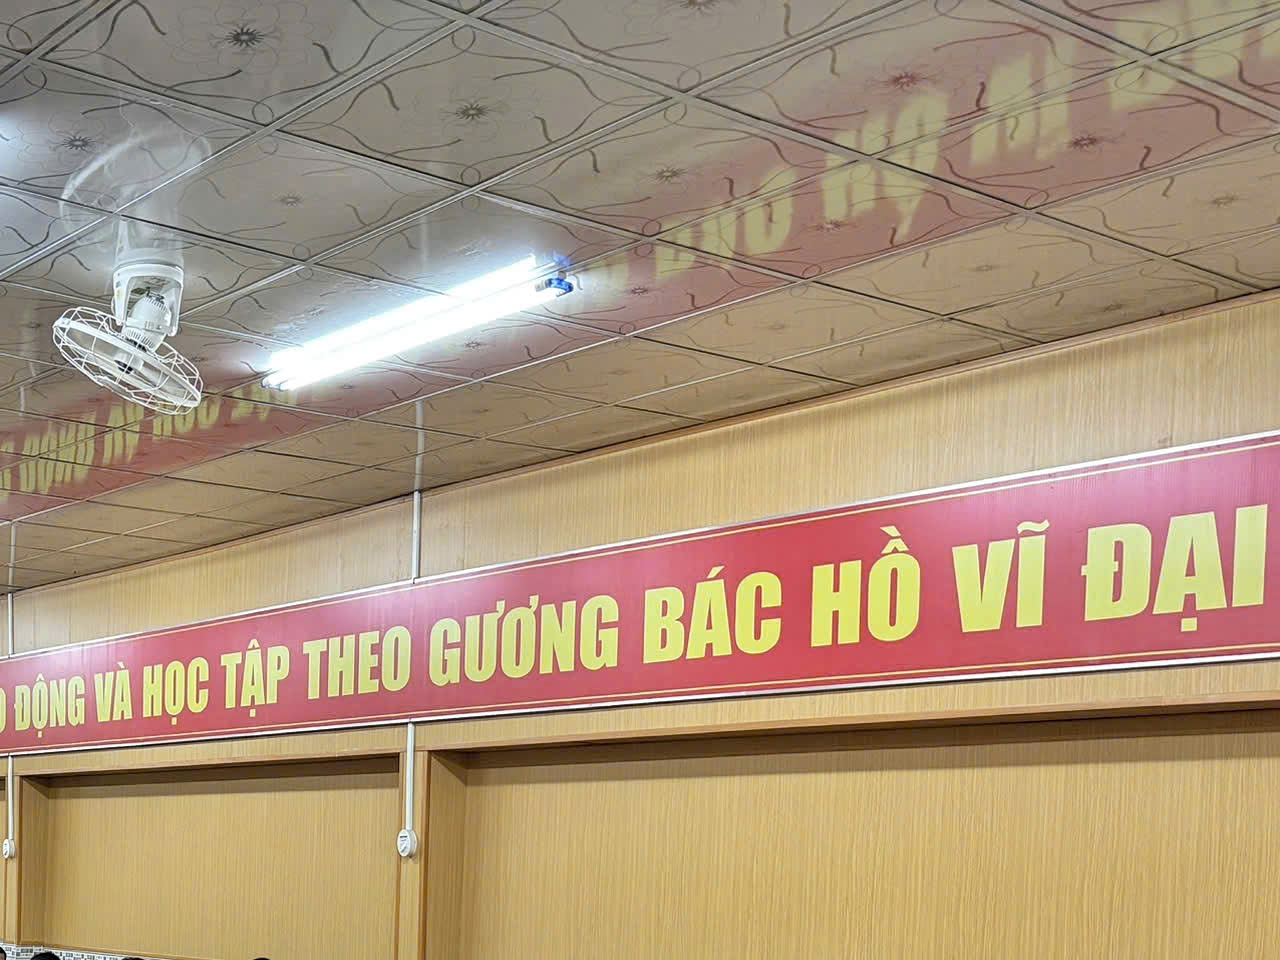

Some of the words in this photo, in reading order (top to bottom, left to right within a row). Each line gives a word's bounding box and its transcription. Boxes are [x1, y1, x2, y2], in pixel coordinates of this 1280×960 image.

[14, 672, 86, 739] ĐỘNG
[94, 661, 133, 723] VÀ
[142, 656, 210, 726] HỌC
[220, 638, 291, 718] TẬP
[303, 625, 412, 701] THEO
[428, 594, 620, 687] GƯƠNG
[642, 565, 783, 664] BÁC
[810, 525, 921, 647] HỒ
[951, 519, 1050, 633] VĨ
[1081, 503, 1269, 633] ĐẠI
